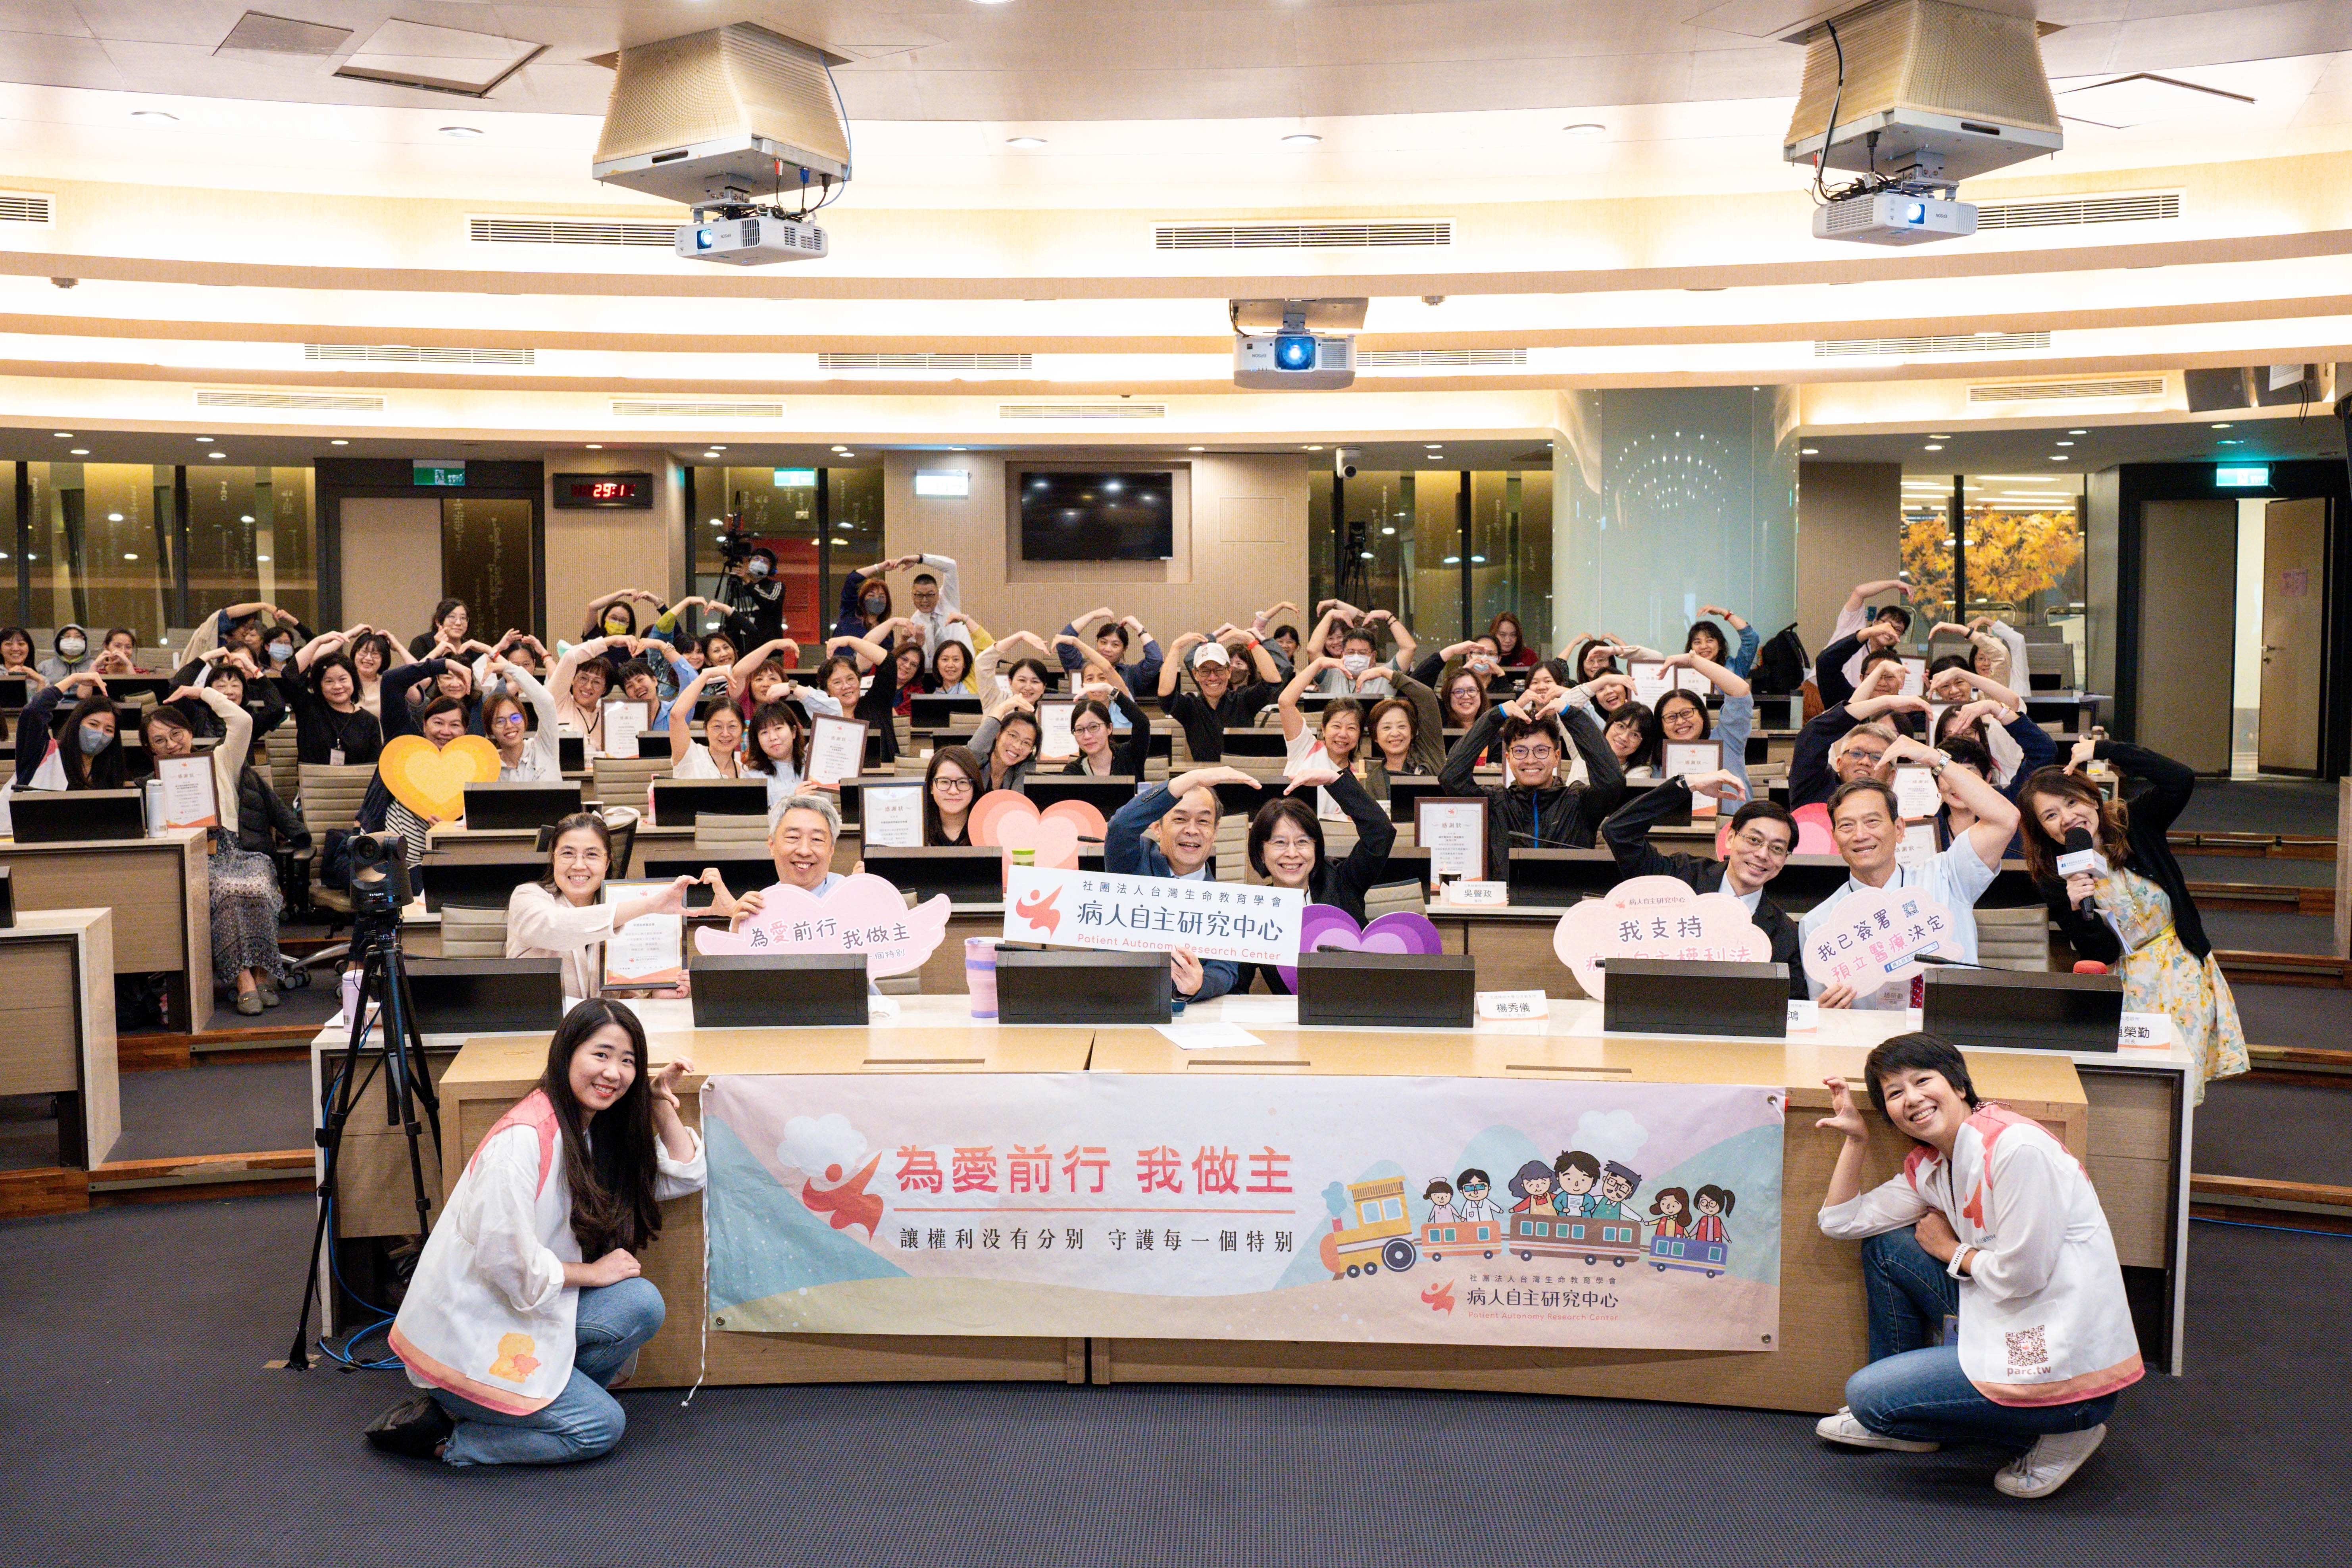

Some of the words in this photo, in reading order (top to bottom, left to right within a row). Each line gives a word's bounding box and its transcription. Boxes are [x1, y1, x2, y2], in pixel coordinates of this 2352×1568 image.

[1082, 880, 1283, 908] 社團法人台灣生命教育學會
[1629, 896, 1686, 905] 病人自主研究中心
[750, 918, 837, 947] 為愛前行
[842, 922, 910, 949] 我做主
[1077, 899, 1283, 941] 病人自主研究中心
[1619, 915, 1702, 943] 我支持
[1077, 933, 1118, 946] Patient
[1242, 949, 1281, 960] Center
[1817, 908, 1890, 962] 我已簽署
[1831, 915, 1944, 983] 預立醫療決定
[1496, 1002, 1531, 1013] 楊秀儀
[1787, 1010, 1798, 1021] 鴻
[895, 1144, 1110, 1194] 為愛前行
[1136, 1145, 1293, 1195] 我做主
[1469, 1274, 1616, 1285] 社團法人台灣生命教育學會
[1467, 1287, 1619, 1308] 病人自主研究中心
[1502, 1312, 1544, 1321] Autonomy
[2007, 1365, 2051, 1376] parc.tw
